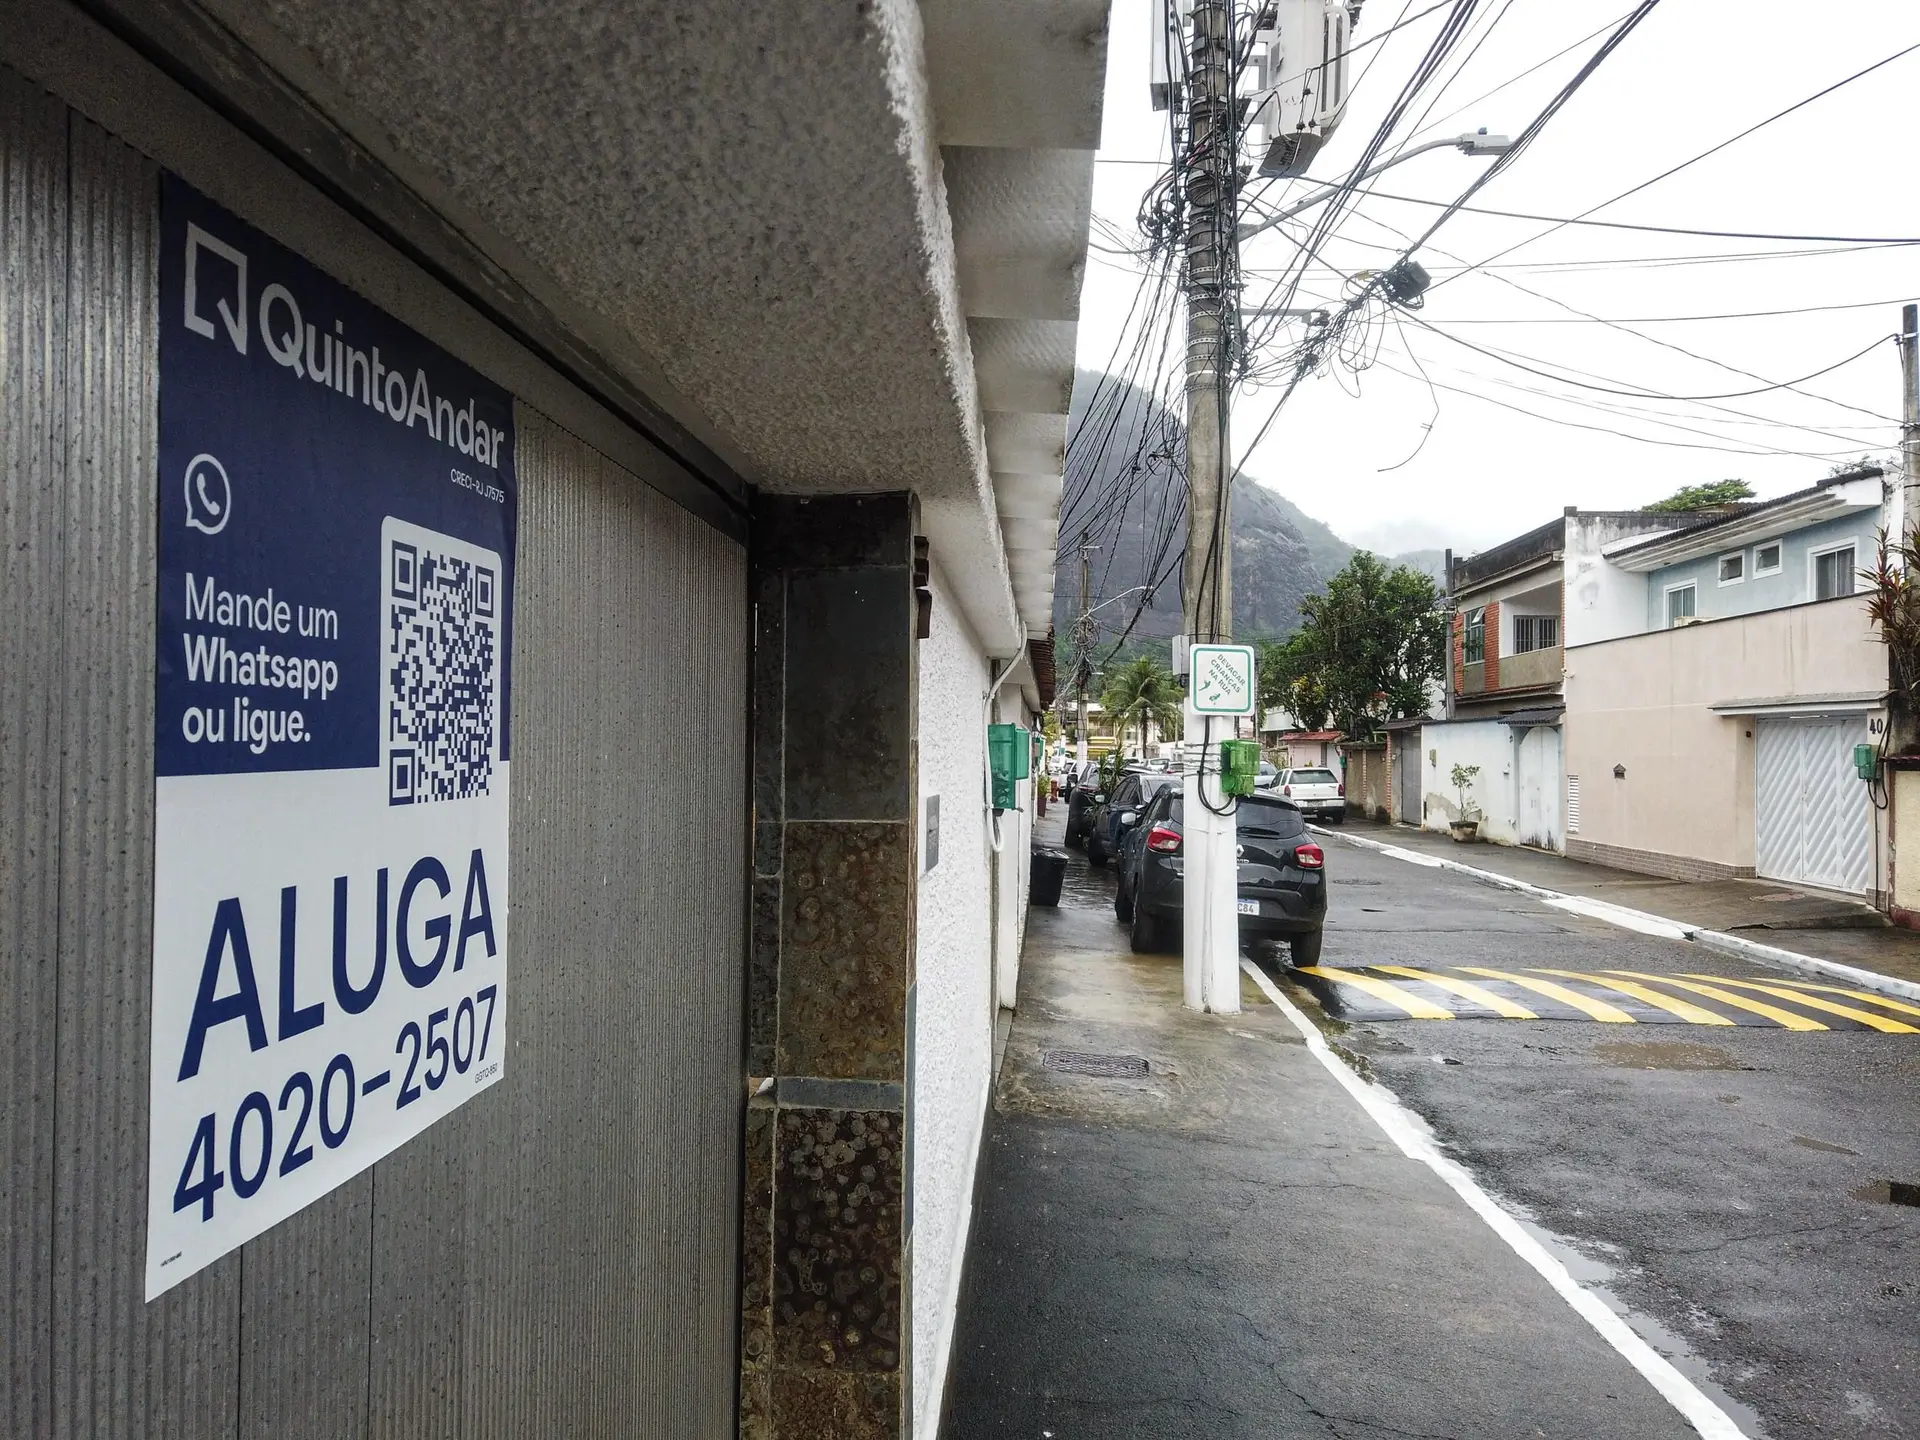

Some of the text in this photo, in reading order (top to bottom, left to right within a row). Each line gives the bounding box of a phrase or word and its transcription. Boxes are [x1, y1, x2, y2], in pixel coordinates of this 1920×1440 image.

[259, 283, 504, 469] QuintoAndar
[451, 468, 505, 503] CRECI-RJ J7575
[185, 572, 338, 640] Mande um
[183, 633, 338, 700] Whatsapp
[1208, 669, 1231, 695] NA RUA
[1210, 659, 1241, 693] CRIANÇAS
[1217, 654, 1246, 686] DEVAGAR
[182, 697, 311, 755] ou ligue.
[1869, 718, 1884, 735] 40
[177, 848, 497, 1083] ALUGA
[173, 984, 497, 1223] 4020-2507
